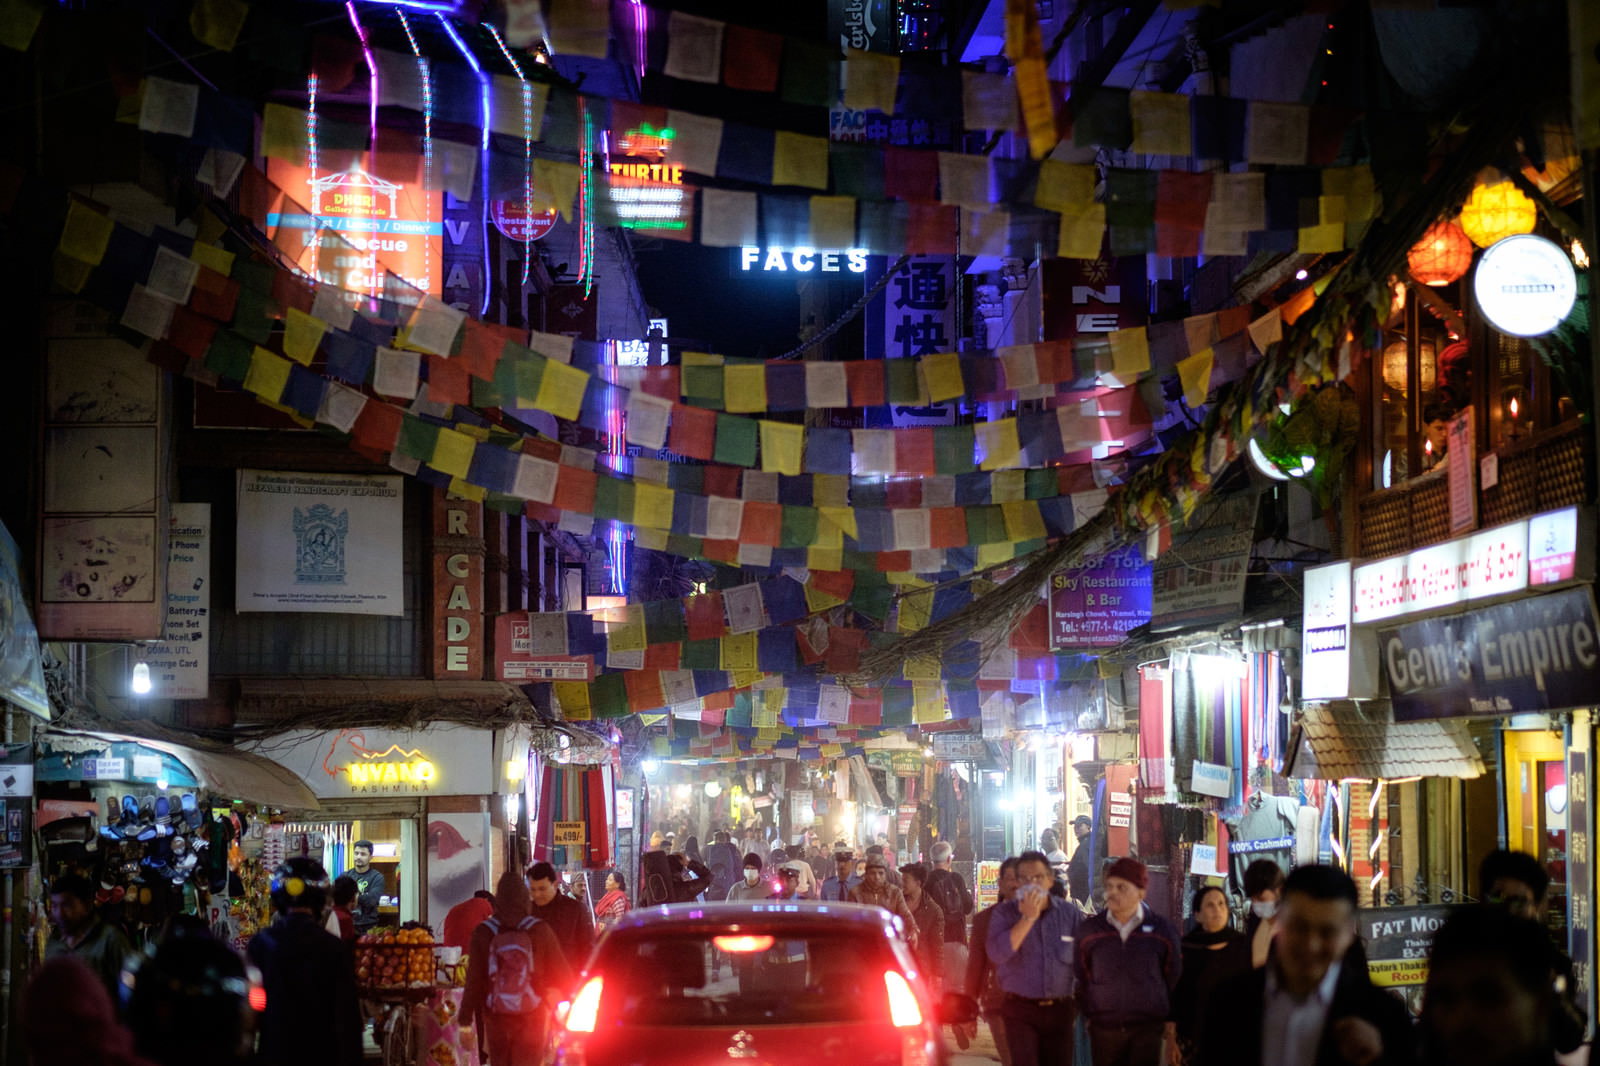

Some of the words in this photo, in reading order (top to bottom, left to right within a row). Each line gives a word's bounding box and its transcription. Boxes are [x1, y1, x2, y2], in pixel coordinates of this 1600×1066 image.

[392, 222, 431, 232] Dinner
[334, 253, 376, 269] and
[740, 247, 868, 273] FACES
[247, 483, 291, 494] NEPALESE
[294, 485, 349, 496] HANDICRAFT
[351, 487, 398, 498] EMPORIUM
[175, 541, 200, 550] Phone
[173, 554, 194, 563] Price
[1110, 555, 1146, 570] Top
[1499, 542, 1523, 580] Bar
[1054, 575, 1079, 591] Sky
[1082, 575, 1152, 589] Restaurant
[1086, 593, 1096, 606] &
[1100, 593, 1123, 606] Bar
[168, 607, 199, 617] Battery
[186, 619, 200, 628] Set
[1387, 625, 1473, 690] Gem's
[1477, 617, 1598, 692] Empire
[178, 659, 198, 668] Card
[350, 761, 435, 783] NYANO
[351, 785, 429, 794] PASHMINA
[1231, 842, 1253, 853] 100%
[1371, 919, 1405, 939] FAT
